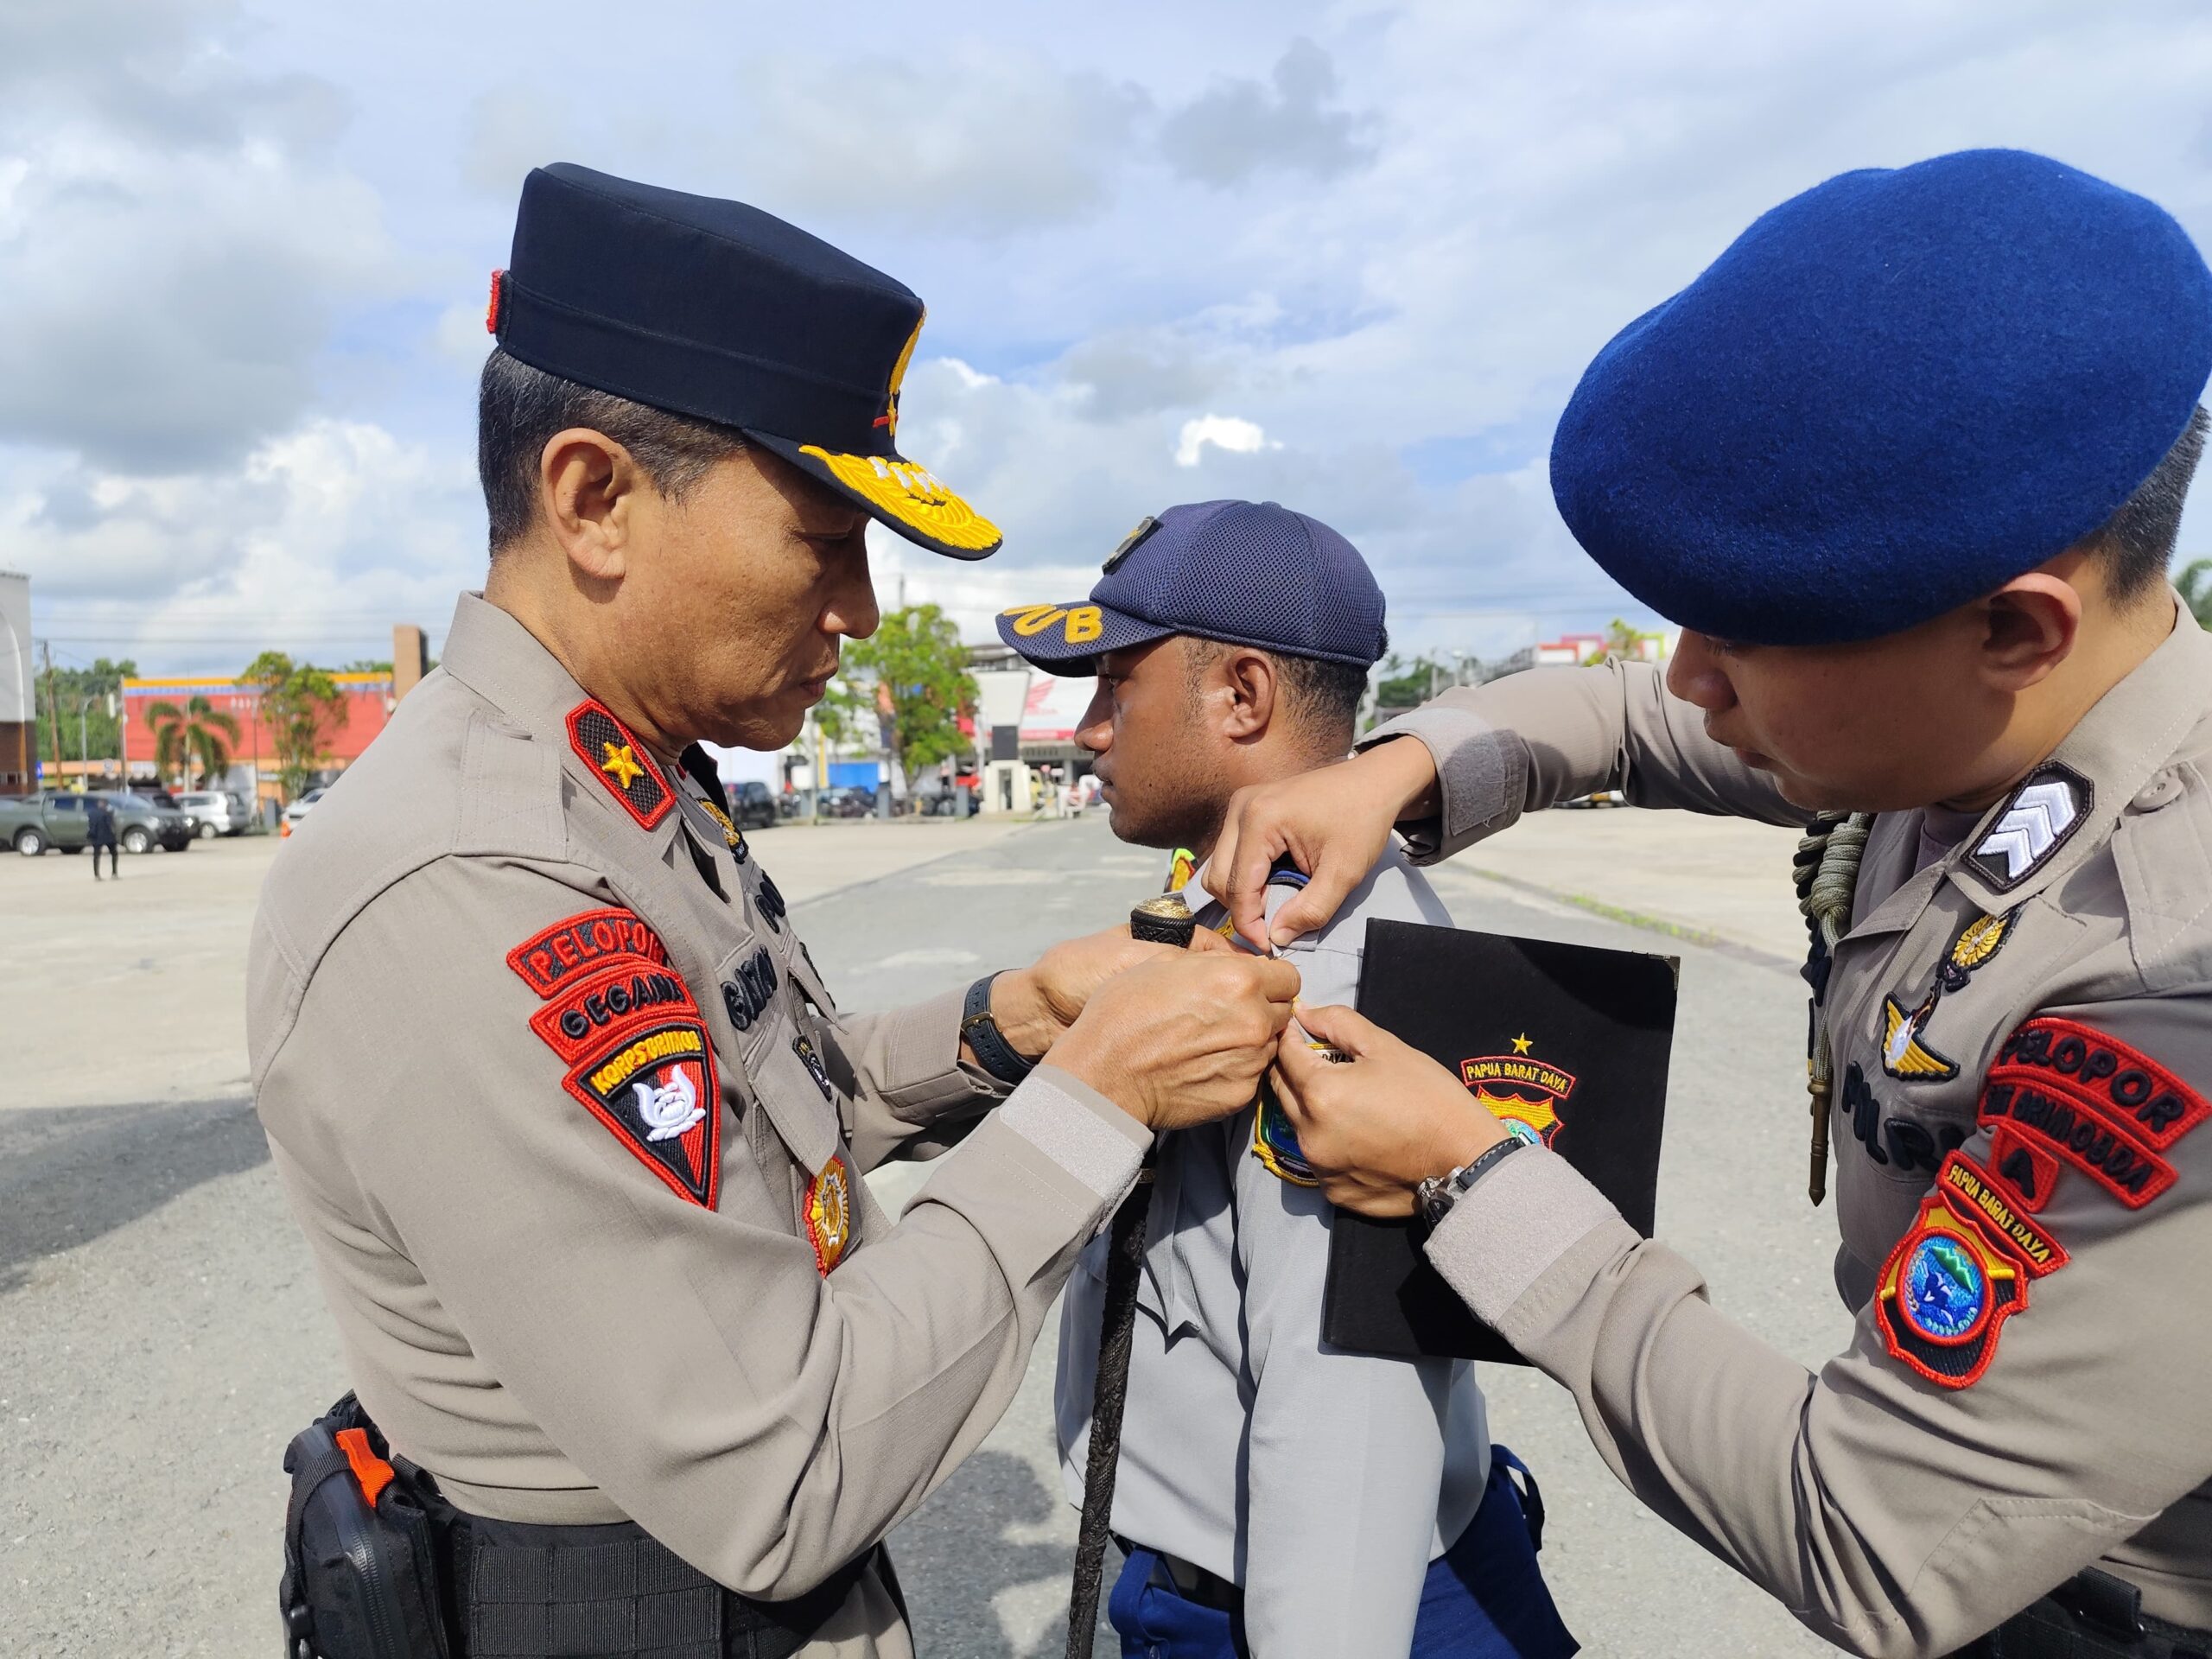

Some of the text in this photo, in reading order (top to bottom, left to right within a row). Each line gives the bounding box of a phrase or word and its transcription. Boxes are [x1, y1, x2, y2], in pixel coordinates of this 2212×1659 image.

[559, 971, 685, 1039] GEGANA
[590, 1040, 648, 1096] KORPS
[1465, 1062, 1567, 1093] PAPUA BARAT DAYA
[1999, 1029, 2186, 1133] PELOPOR
[1999, 1147, 2036, 1199] A
[1948, 1163, 2050, 1263] PAPUA BARAT DAYA
